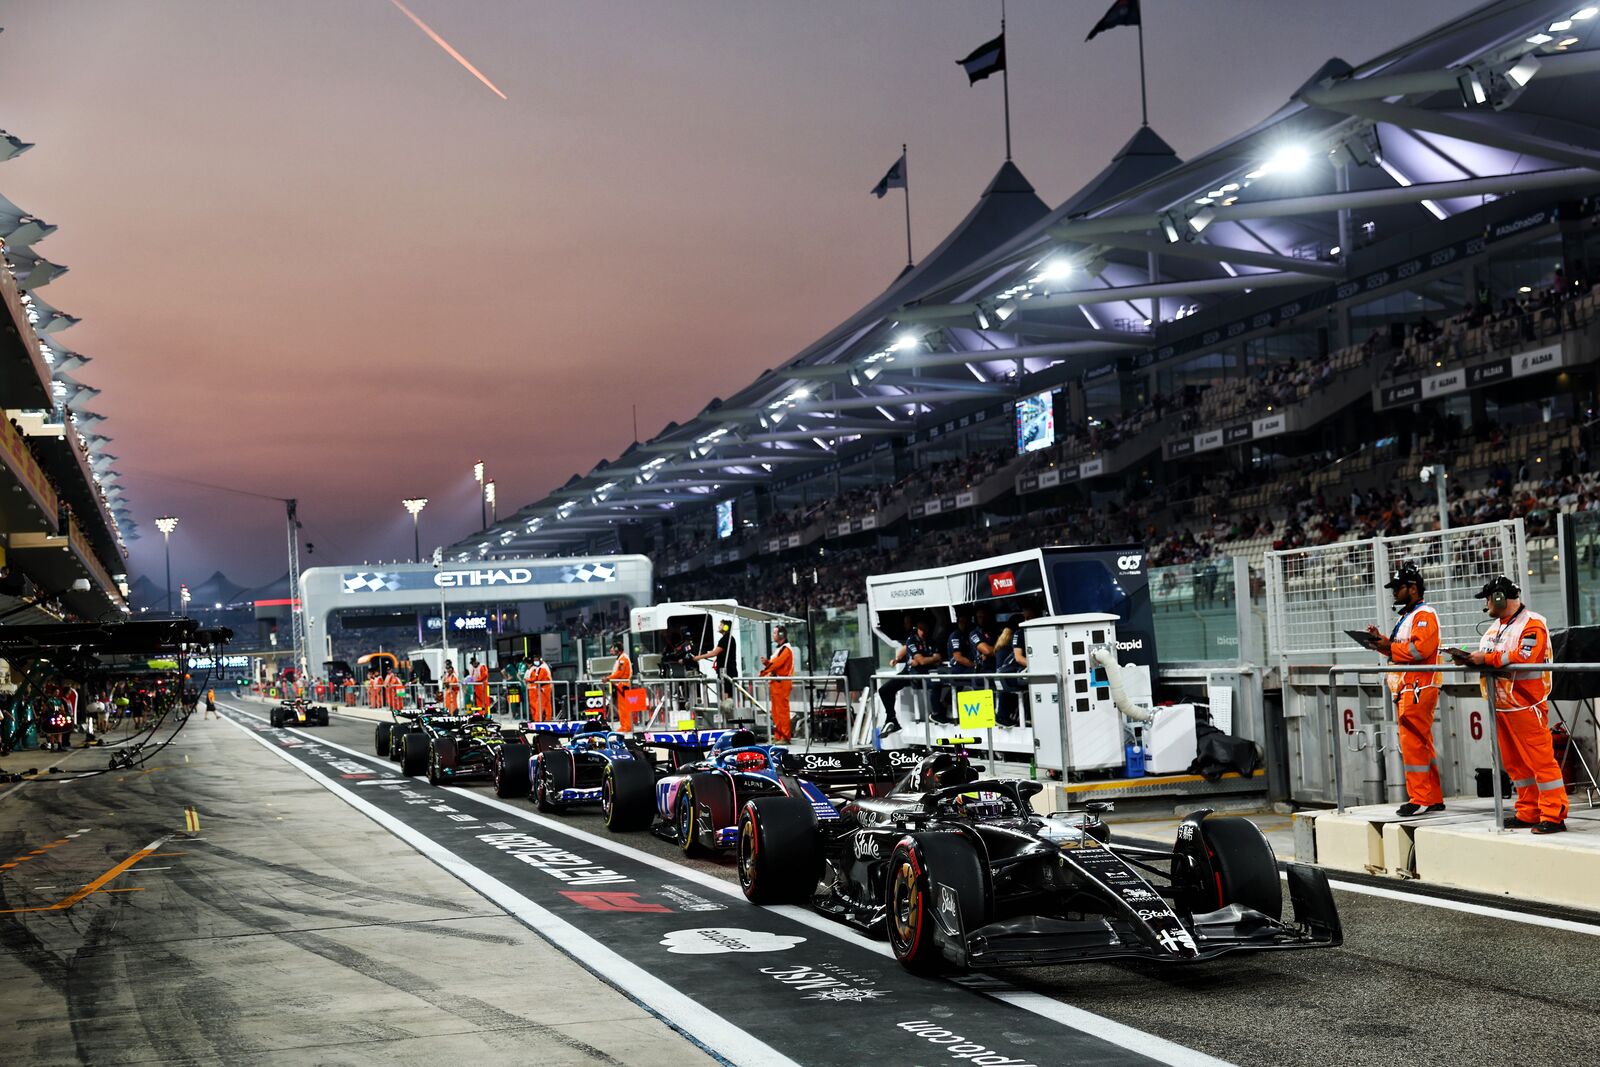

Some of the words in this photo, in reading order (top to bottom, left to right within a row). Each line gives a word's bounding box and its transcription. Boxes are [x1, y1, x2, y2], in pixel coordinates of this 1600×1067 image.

[1531, 353, 1553, 366] ALDAR
[433, 568, 532, 587] ETIHAD
[964, 703, 980, 717] W
[1343, 708, 1355, 735] 6
[1469, 711, 1483, 740] 6
[805, 754, 841, 769] Stake
[889, 751, 924, 766] Stake
[744, 780, 763, 788] ALPINE
[854, 829, 881, 860] Stake
[1060, 839, 1101, 849] 24
[758, 966, 851, 990] MSC
[897, 1020, 1038, 1067] pto.com
